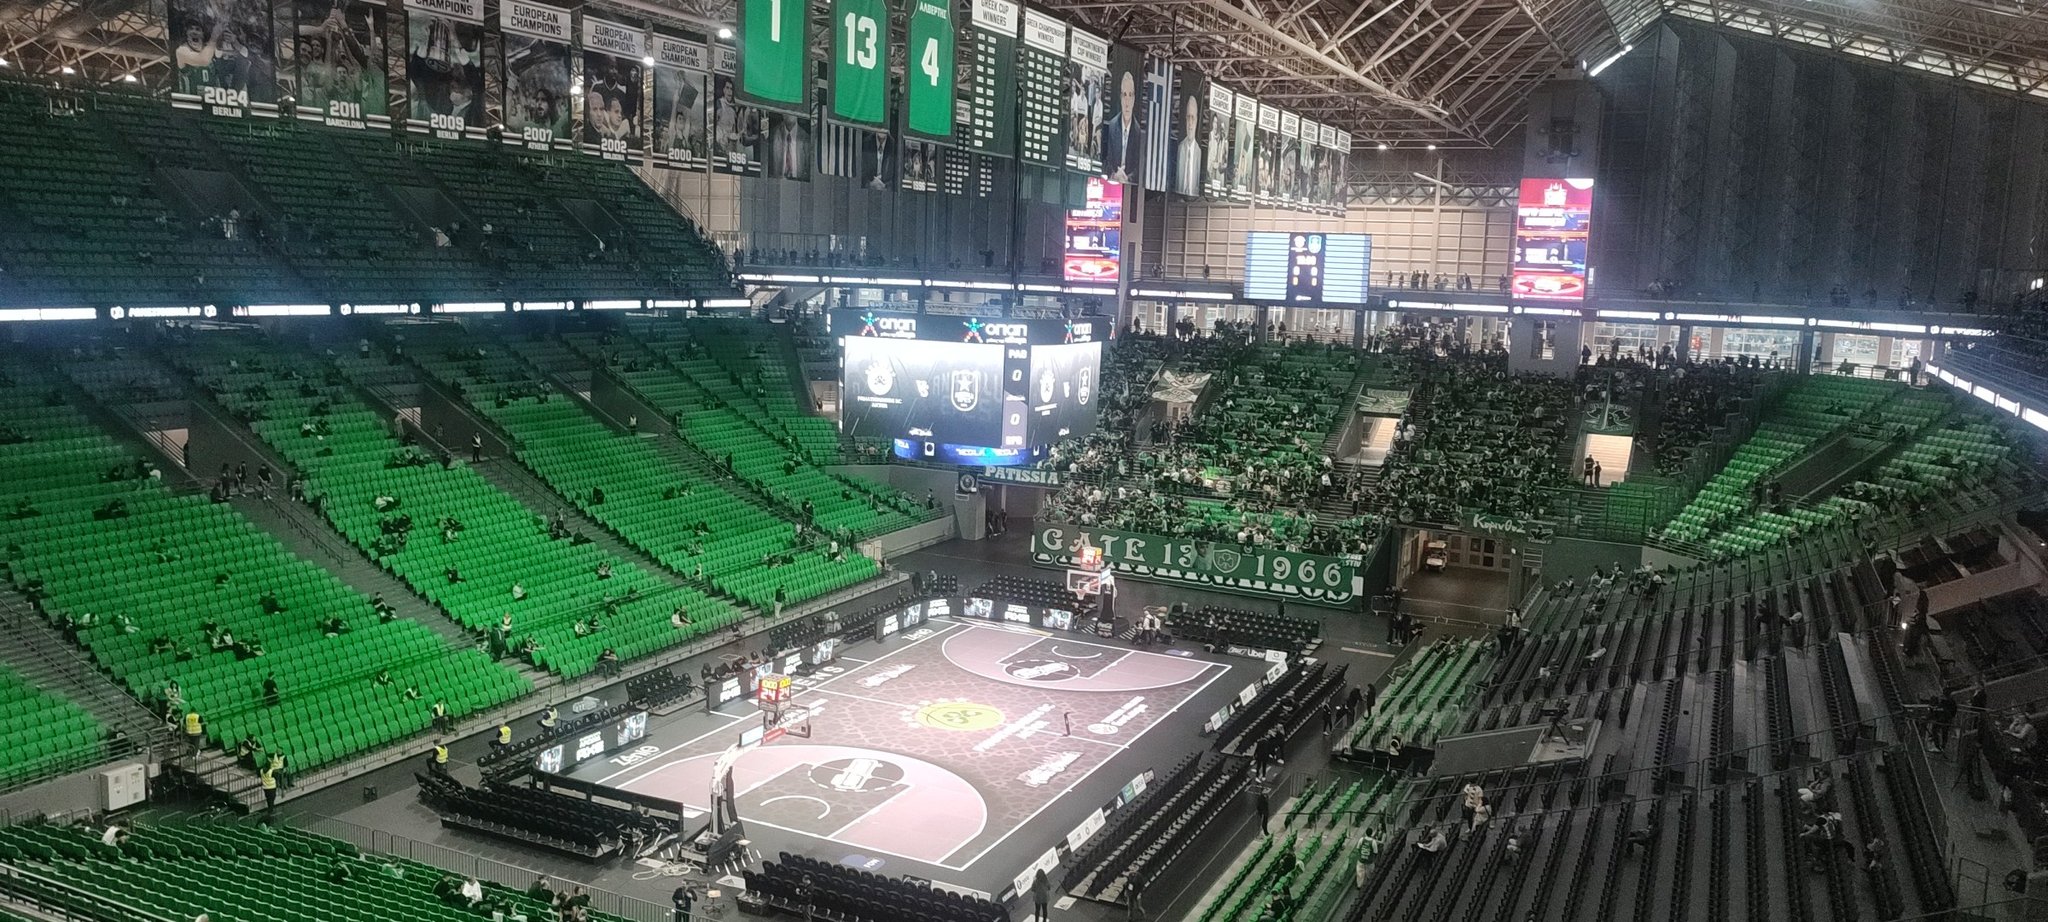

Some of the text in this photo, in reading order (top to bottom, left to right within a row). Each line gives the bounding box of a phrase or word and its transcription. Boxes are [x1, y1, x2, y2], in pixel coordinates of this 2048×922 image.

[513, 5, 559, 24] EUROPEAN
[998, 3, 1010, 15] CUP
[511, 17, 562, 36] CHAMPIONS
[982, 10, 1007, 27] WINNERS
[594, 24, 634, 42] EUROPEAN
[845, 12, 878, 70] 13
[592, 35, 637, 54] CHAMPIONS
[662, 41, 698, 57] EUROPEAN
[660, 51, 700, 68] CHAMPIONS
[920, 37, 940, 87] 4
[204, 86, 248, 108] 2024
[212, 105, 242, 118] BERLIN
[329, 100, 361, 119] 2011
[326, 117, 366, 130] BARCELONA
[430, 112, 465, 131] 2009
[523, 126, 552, 143] 2007
[601, 137, 628, 154] 2002
[668, 147, 692, 163] 2000
[728, 151, 747, 166] 1996
[1012, 369, 1023, 382] 0
[1010, 413, 1021, 426] 0
[984, 464, 1060, 485] PATISSIA
[1042, 527, 1146, 563] GATE
[1162, 542, 1193, 568] 13
[1254, 554, 1342, 587] 1966
[1247, 648, 1266, 659] Uber
[760, 687, 776, 701] 24
